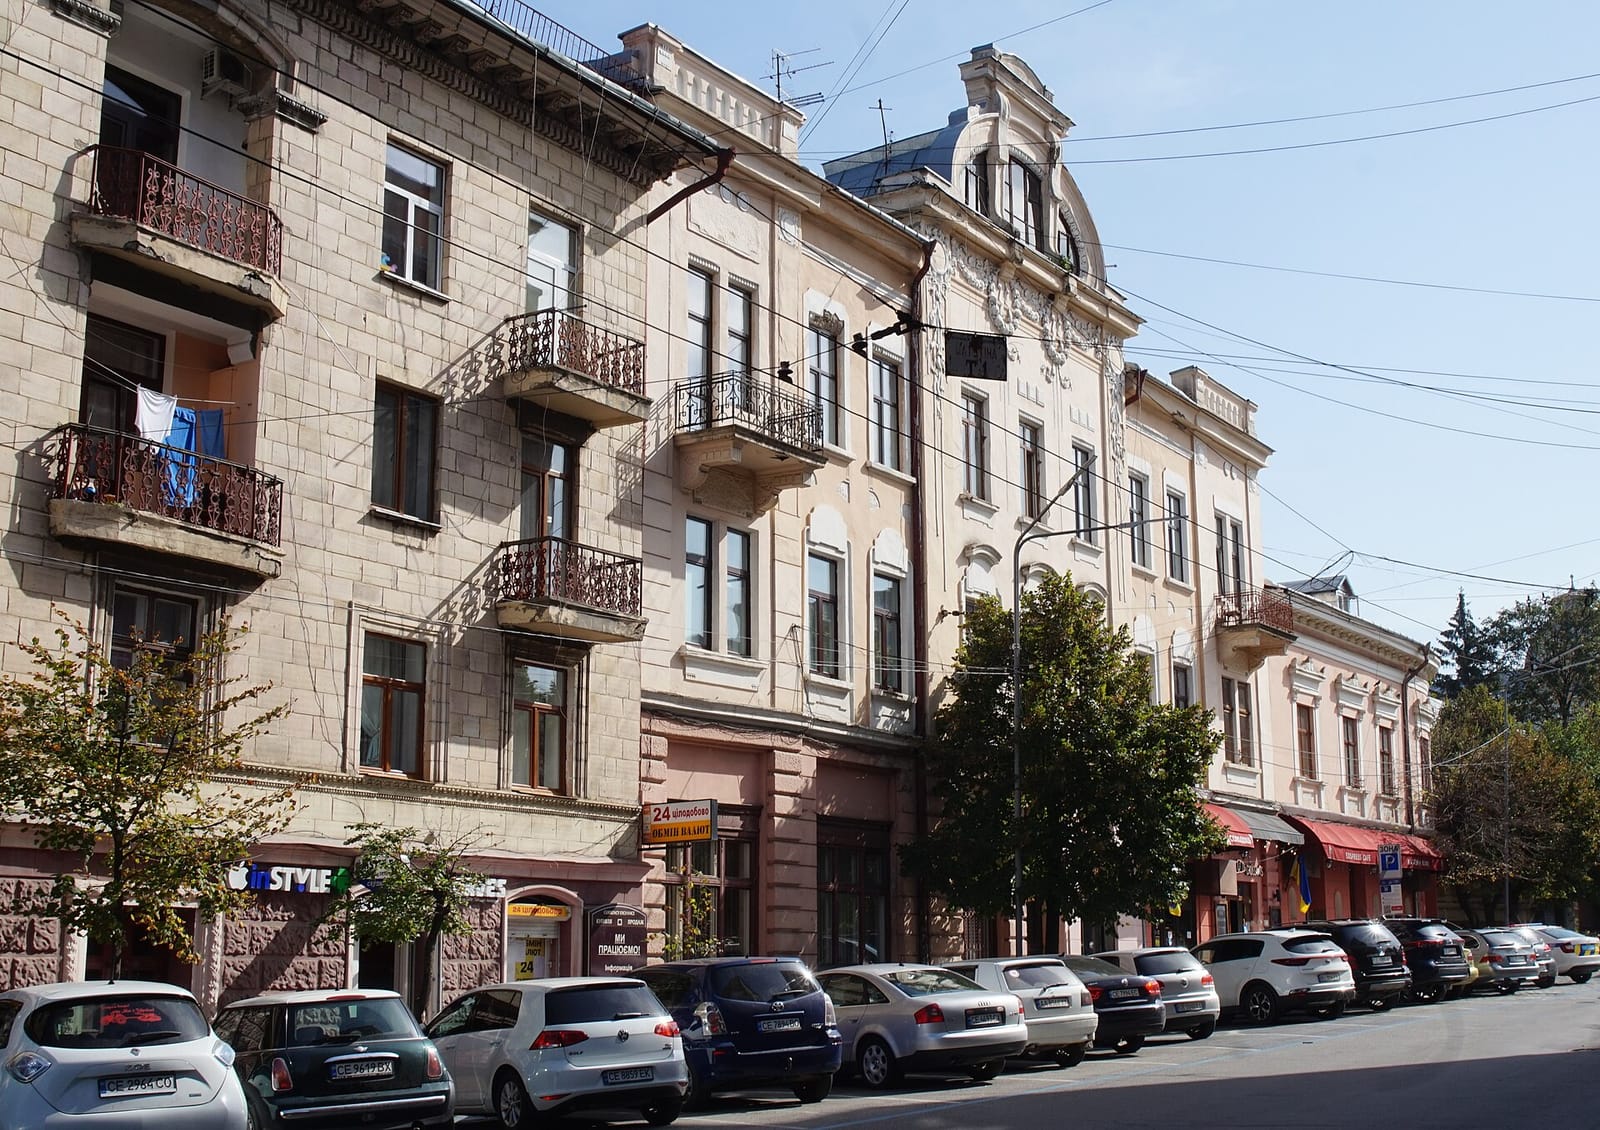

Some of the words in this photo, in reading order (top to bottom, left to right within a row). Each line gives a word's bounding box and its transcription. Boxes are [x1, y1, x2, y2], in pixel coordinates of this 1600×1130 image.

[653, 806, 671, 822] 24
[672, 806, 710, 818] цілодобово
[652, 827, 679, 838] ОБМІН
[681, 825, 710, 836] ВАЛЮТ
[614, 934, 626, 944] МИ
[598, 945, 641, 955] ПРАЦЮЄМО!
[520, 961, 534, 973] 24
[337, 1063, 351, 1075] CE
[353, 1062, 376, 1074] 9619
[608, 1071, 620, 1081] CE
[107, 1080, 124, 1092] CE
[127, 1078, 153, 1091] 2964
[155, 1076, 172, 1089] CO
